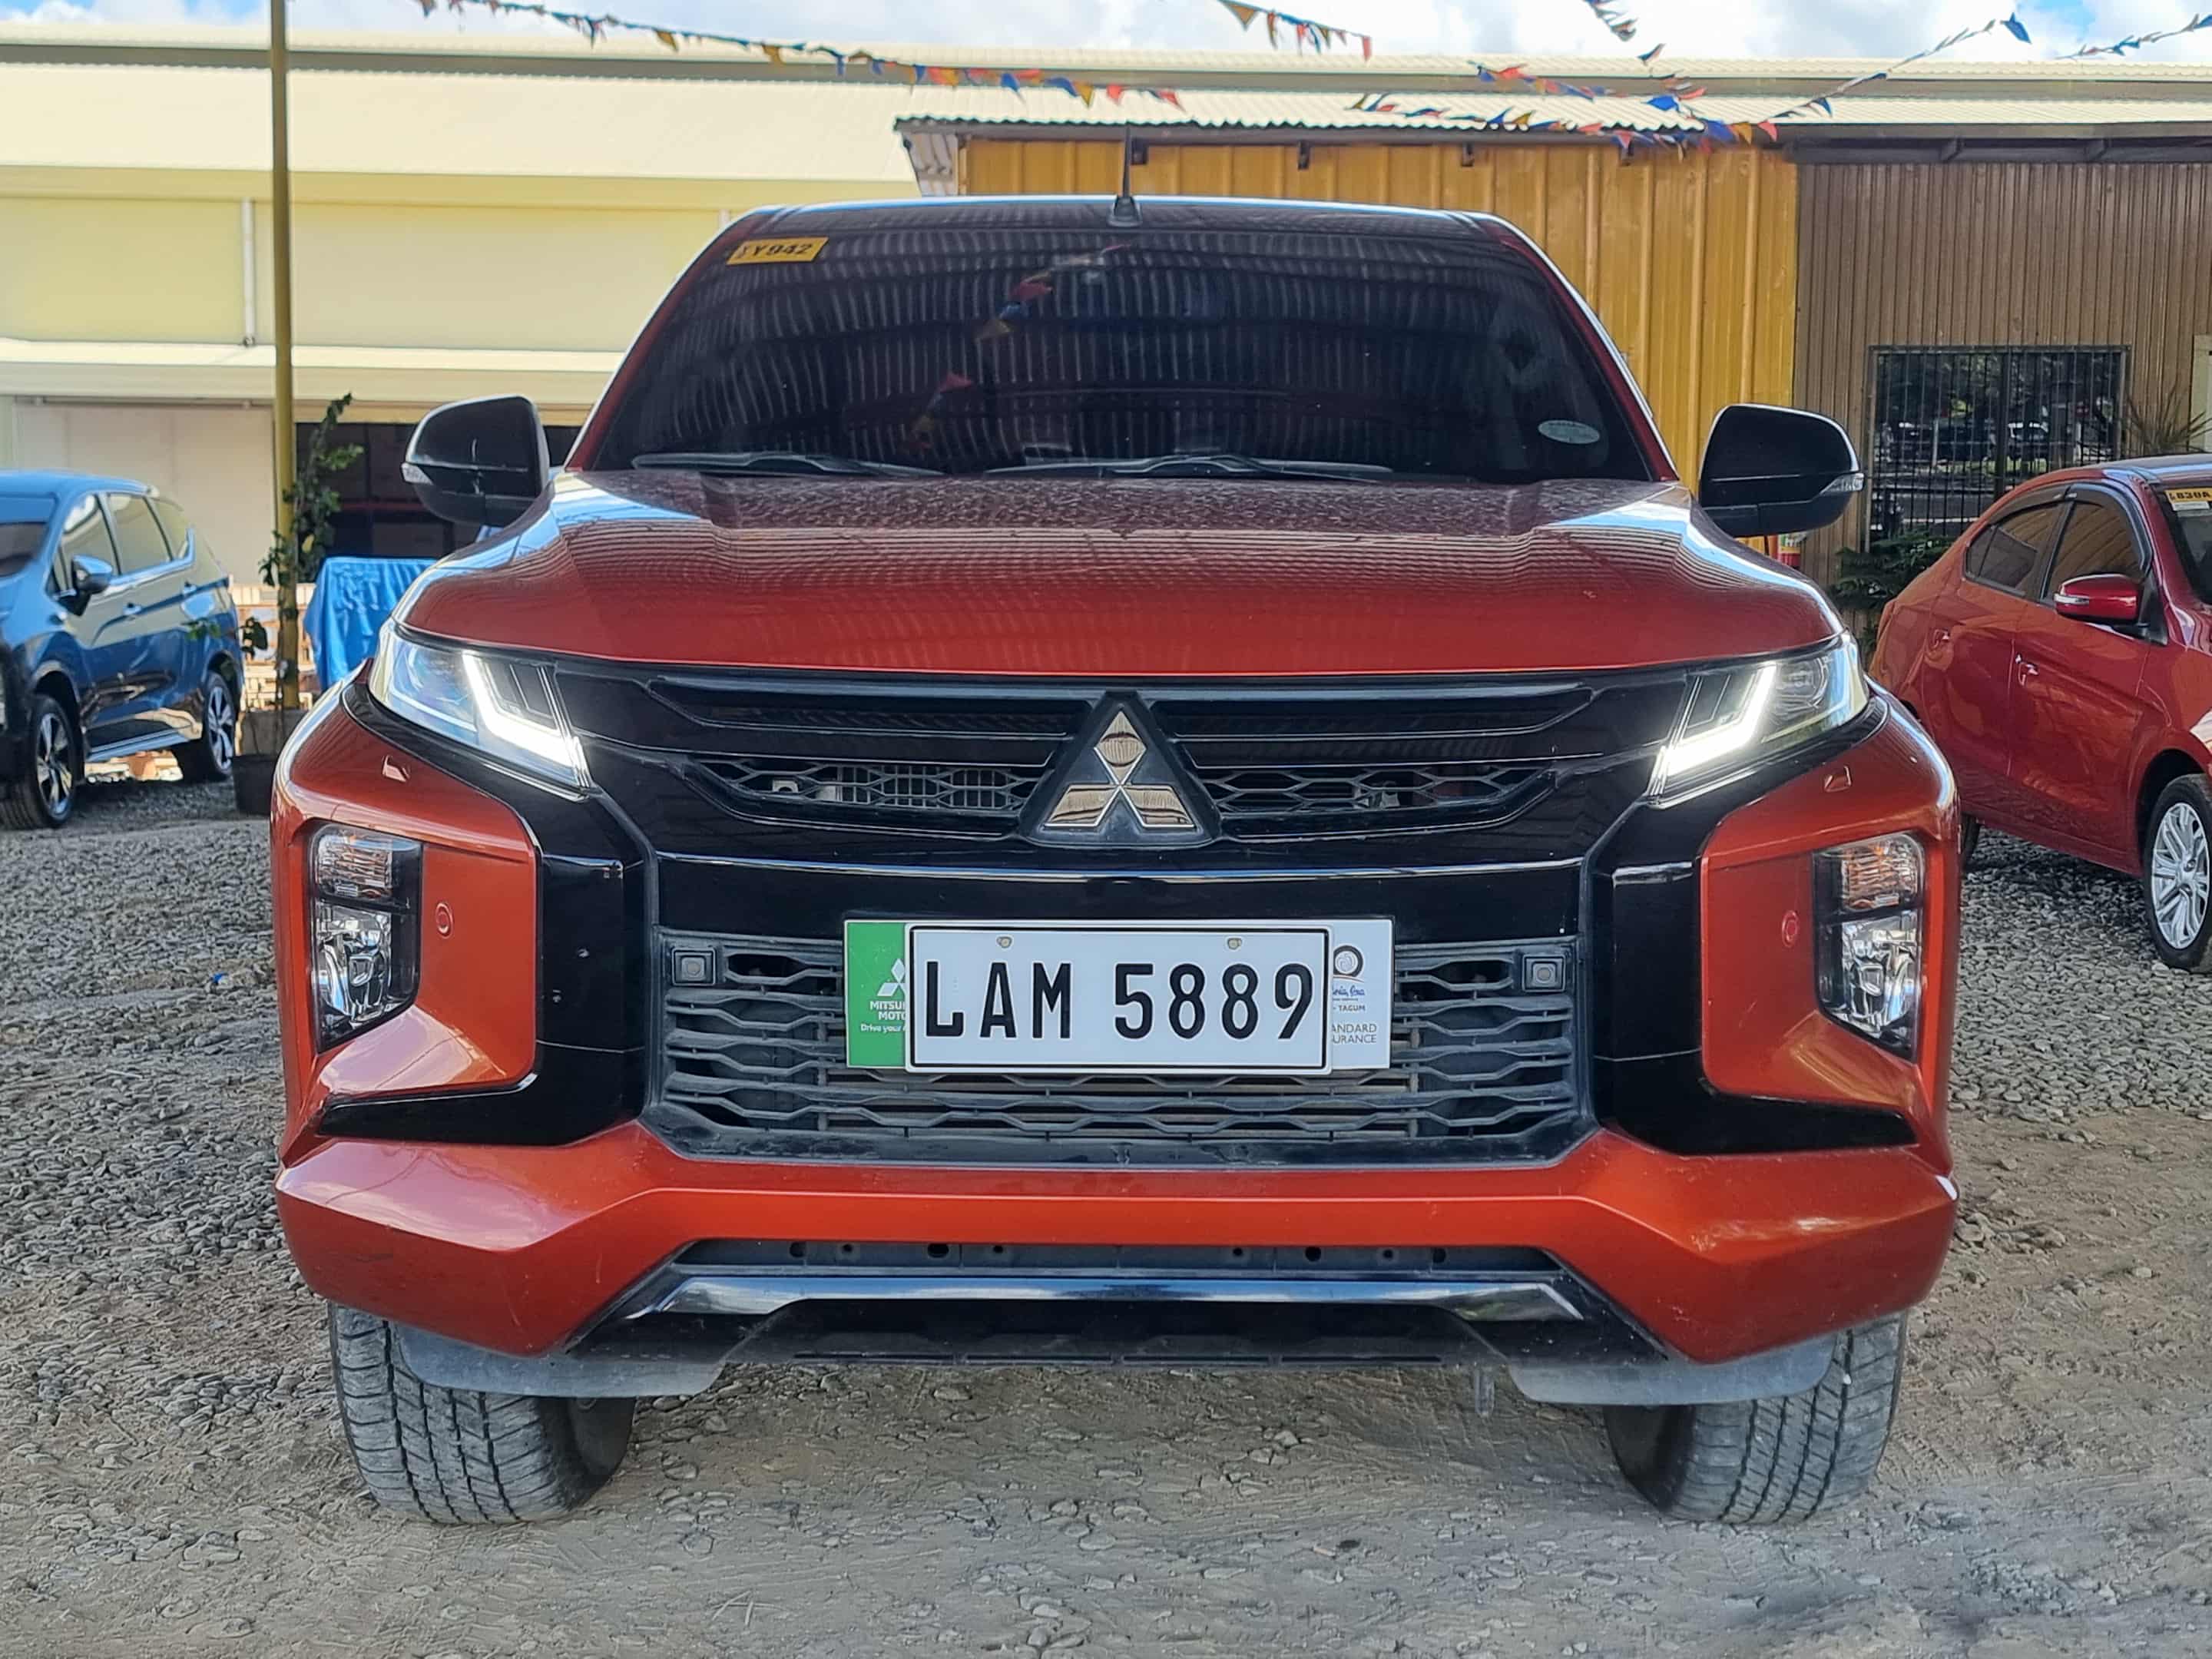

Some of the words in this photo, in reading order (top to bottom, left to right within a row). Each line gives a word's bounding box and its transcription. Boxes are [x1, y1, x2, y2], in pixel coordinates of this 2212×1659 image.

[869, 1001, 906, 1010] MITSU
[926, 962, 1071, 1038] LAM
[1114, 963, 1313, 1039] 5889
[860, 1023, 882, 1031] Drive
[882, 1025, 902, 1035] your
[1332, 1034, 1377, 1044] URANCE
